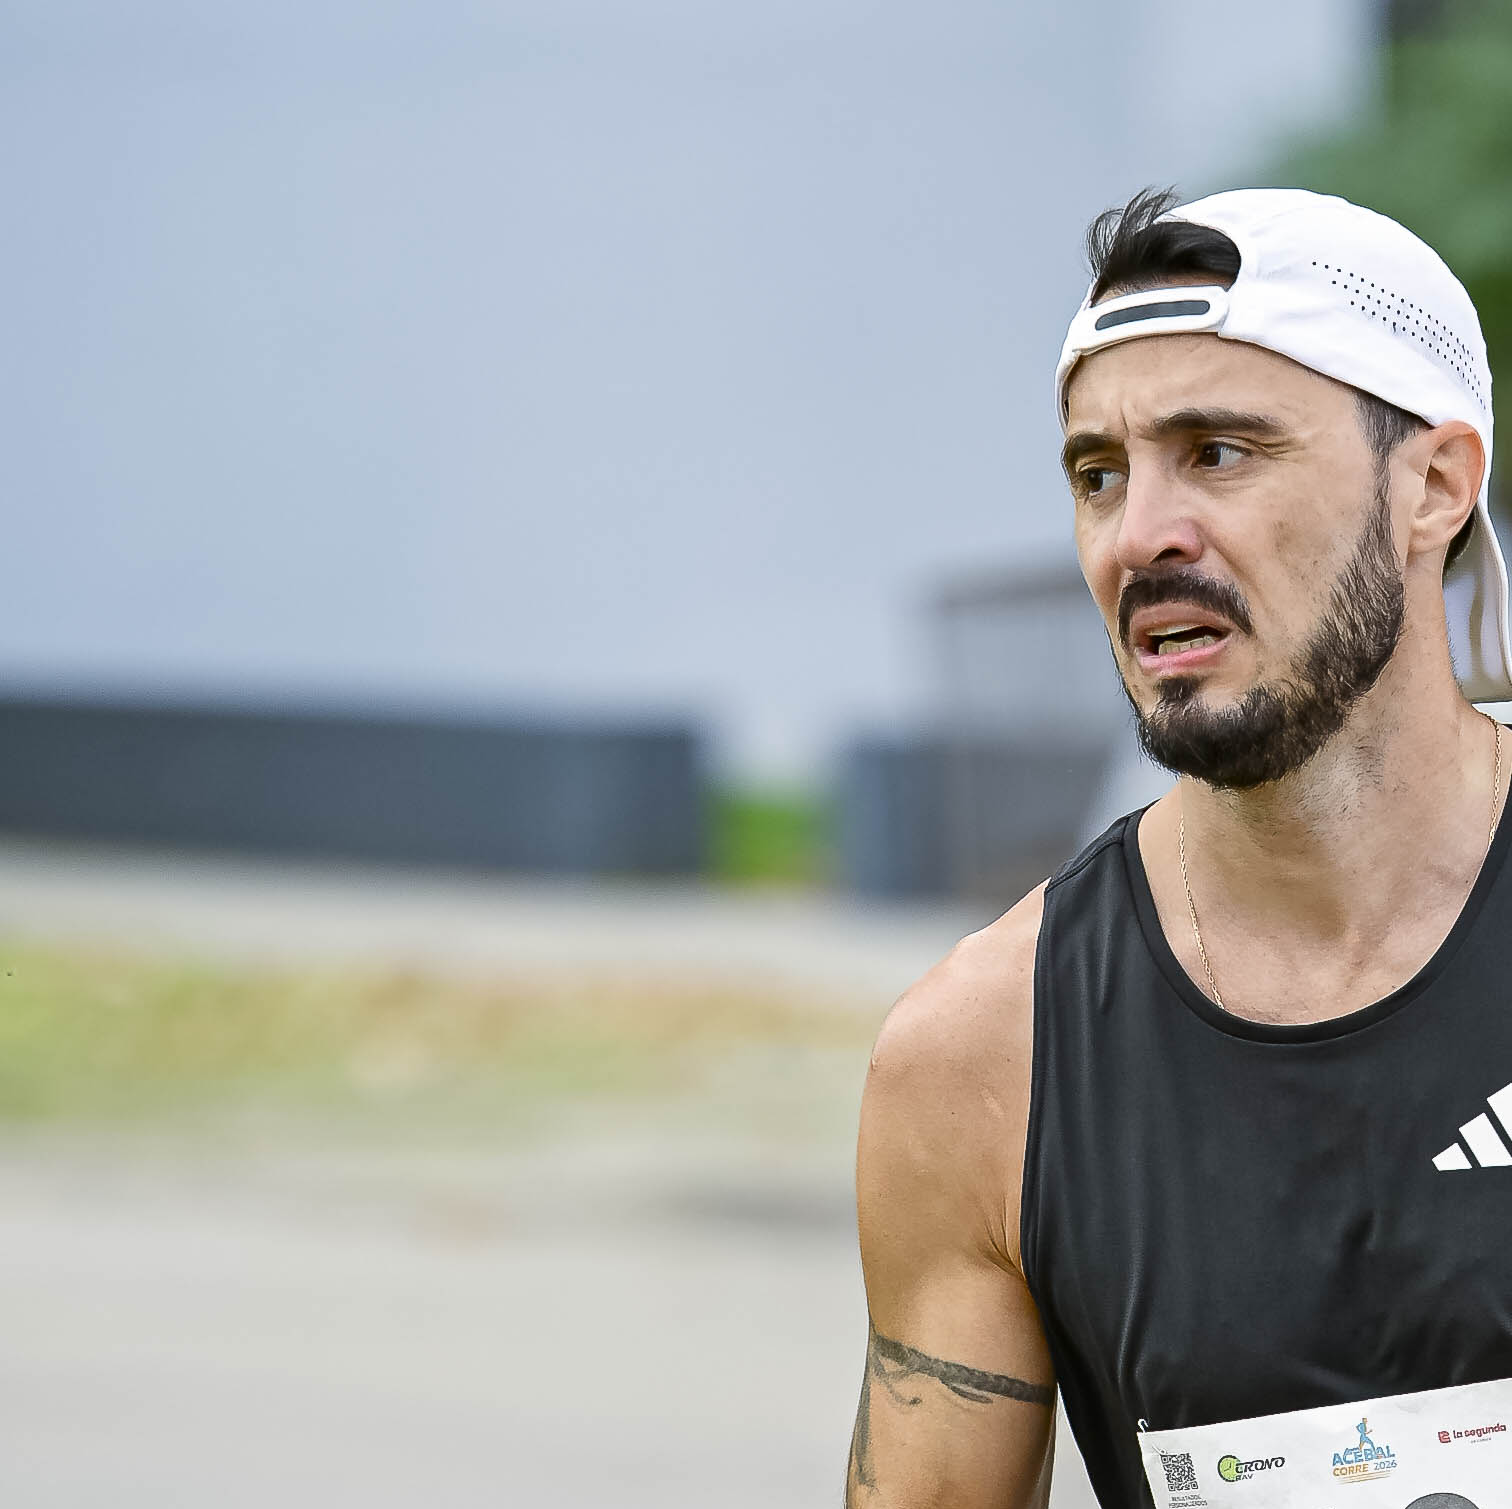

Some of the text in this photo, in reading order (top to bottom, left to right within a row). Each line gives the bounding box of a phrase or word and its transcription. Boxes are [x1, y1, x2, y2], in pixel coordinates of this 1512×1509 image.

[1235, 1456, 1286, 1474] CRONO
[1332, 1445, 1396, 1467] ACEBAL
[1333, 1459, 1398, 1477] CORRE 2026
